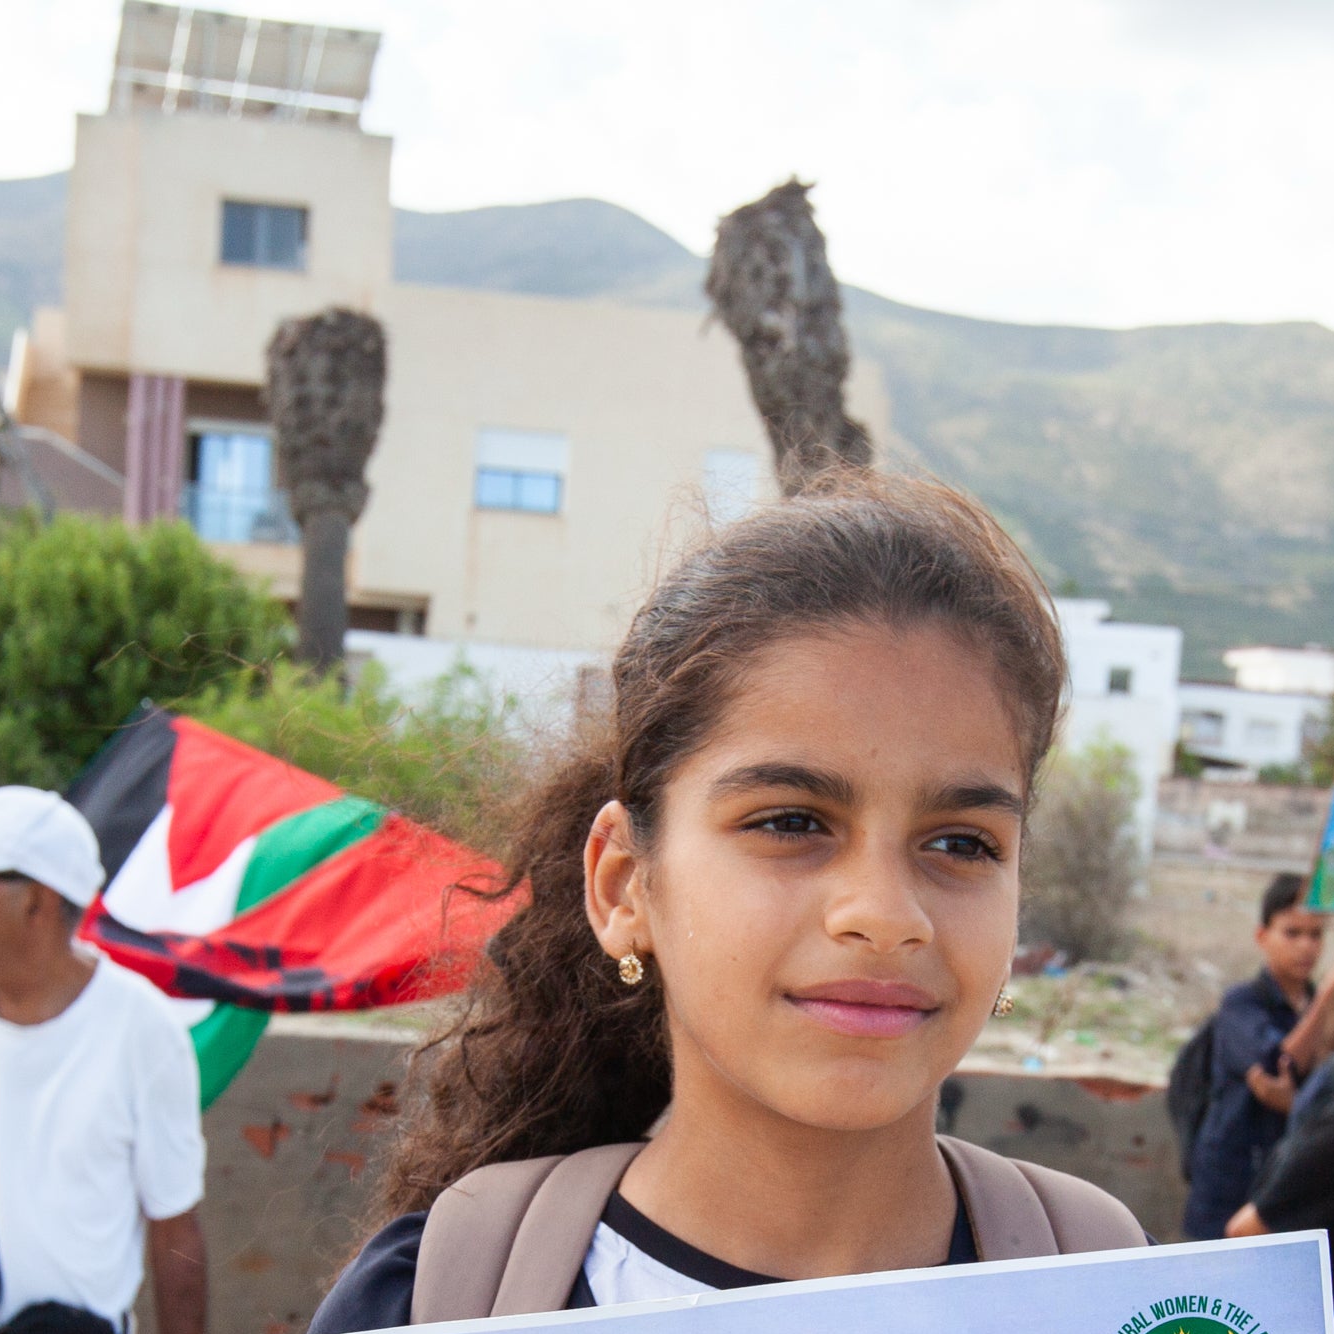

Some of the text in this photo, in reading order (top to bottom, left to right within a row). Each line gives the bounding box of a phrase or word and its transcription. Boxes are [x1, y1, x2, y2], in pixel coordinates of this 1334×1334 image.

[1149, 1295, 1208, 1321] WOMEN
[1210, 1298, 1223, 1317] &
[1224, 1302, 1254, 1331] THE
